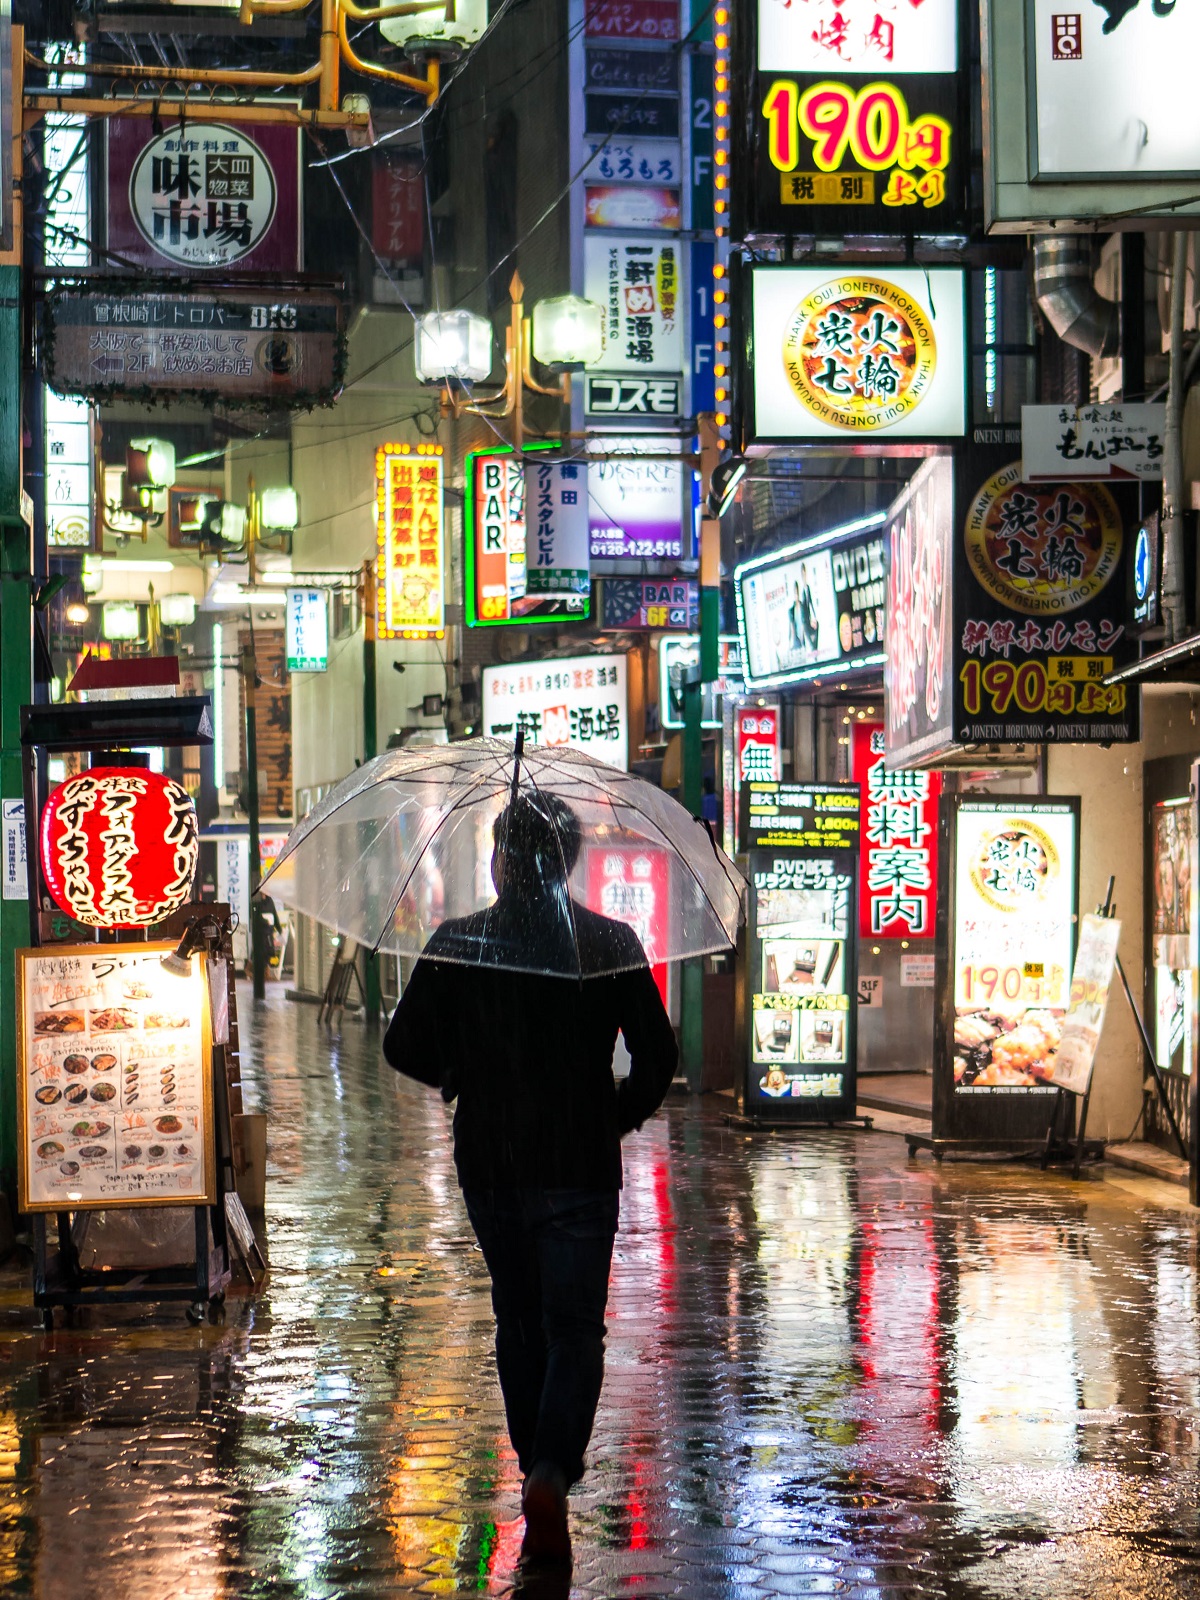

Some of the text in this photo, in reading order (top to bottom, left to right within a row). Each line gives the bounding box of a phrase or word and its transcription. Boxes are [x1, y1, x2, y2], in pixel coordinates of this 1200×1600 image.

[811, 12, 895, 63] 焼肉
[164, 140, 239, 152] 創作料理
[152, 154, 201, 199] 味
[209, 157, 250, 174] 大皿
[600, 158, 673, 180] もろもろ
[209, 179, 249, 196] 惣菜
[791, 176, 864, 201] 税別
[881, 169, 945, 209] より
[152, 200, 253, 247] 市場
[624, 246, 656, 364] 一軒め酒場
[787, 282, 931, 348] THANK YOU! JONETSU HORUMON
[90, 331, 247, 353] 大阪で一番安心して
[127, 354, 153, 373] 2F
[164, 355, 252, 376] 飲めるお店
[591, 380, 676, 412] コスモ
[788, 359, 931, 427] THANK YOU! JONETSU HORUMON
[560, 465, 579, 506] 梅田
[485, 464, 505, 551] BAR
[970, 491, 995, 530] THANK
[991, 468, 1020, 493] YOU!
[536, 463, 555, 567] クリスタルビル
[590, 540, 682, 557] 0120-122-515
[971, 541, 1117, 611] THANK YOU! JONETSU HORUMON
[644, 586, 686, 604] BAR
[481, 596, 506, 618] 6F
[647, 606, 668, 627] 6F
[962, 619, 1126, 658] 新鮮ホルモン
[1057, 660, 1105, 679] 税別
[742, 719, 773, 734] 総合
[971, 724, 1129, 741] JONETSU HORUMON JONETSU HORUMON
[741, 742, 775, 780] 無
[103, 778, 143, 791] 洋食
[868, 760, 932, 932] 無料案内
[103, 795, 134, 922] フォアグラ大根
[754, 873, 851, 890] リラクゼーション
[1024, 963, 1044, 974] 税別
[861, 981, 879, 992] B1F
